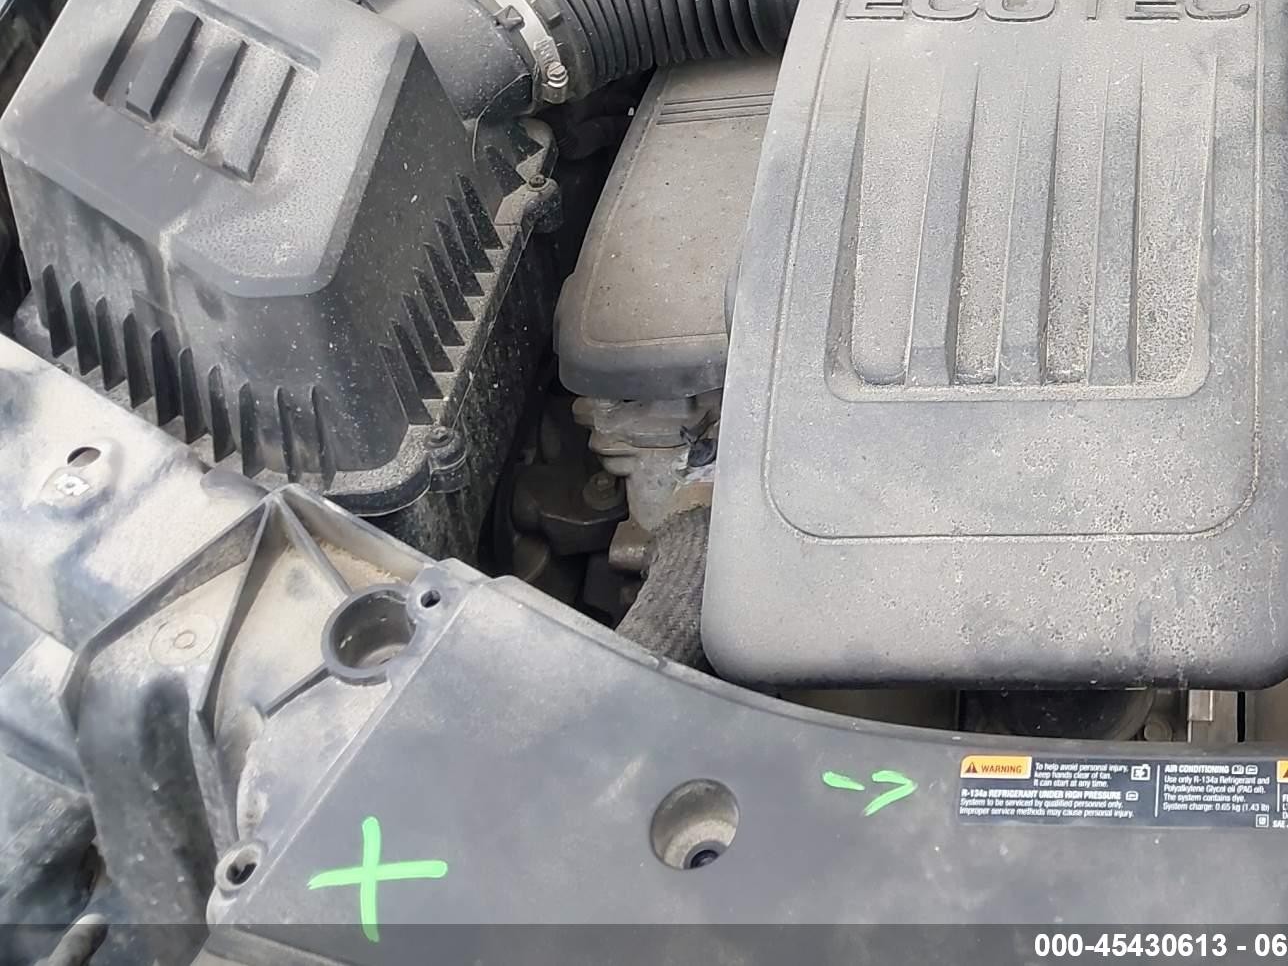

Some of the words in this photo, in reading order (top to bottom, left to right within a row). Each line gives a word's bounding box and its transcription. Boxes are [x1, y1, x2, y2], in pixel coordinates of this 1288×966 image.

[982, 765, 1022, 774] WARNING
[1036, 763, 1043, 771] To
[1044, 764, 1059, 772] help
[1079, 764, 1108, 772] personal
[1164, 765, 1178, 773] AIR
[1178, 765, 1230, 774] CONDITIONING
[1034, 771, 1051, 779] keep
[1052, 771, 1072, 779] hands
[1078, 780, 1090, 788] any
[1164, 776, 1178, 784] Use
[1178, 776, 1192, 784] only
[1193, 776, 1218, 784] R-134a
[1219, 776, 1256, 785] Refrigerant
[1164, 784, 1204, 794] Polyalkylene
[1206, 786, 1226, 794] Glycol
[961, 789, 988, 798] R-134a
[988, 789, 1038, 798] REFRIGERANT
[1038, 790, 1064, 799] UNDER
[1064, 791, 1082, 799] HIGH
[1084, 791, 1122, 800] PRESSURE
[1164, 794, 1176, 802] The
[1178, 794, 1202, 802] system
[1202, 794, 1230, 802] contains
[960, 798, 986, 807] System
[1034, 800, 1043, 808] by
[1044, 800, 1072, 808] qualified
[1074, 801, 1106, 809] personnel
[1163, 802, 1188, 812] System
[1232, 804, 1240, 812] kg
[960, 807, 990, 816] Improper
[1016, 808, 1046, 816] methods
[1046, 809, 1062, 817] may
[1084, 810, 1112, 818] personal
